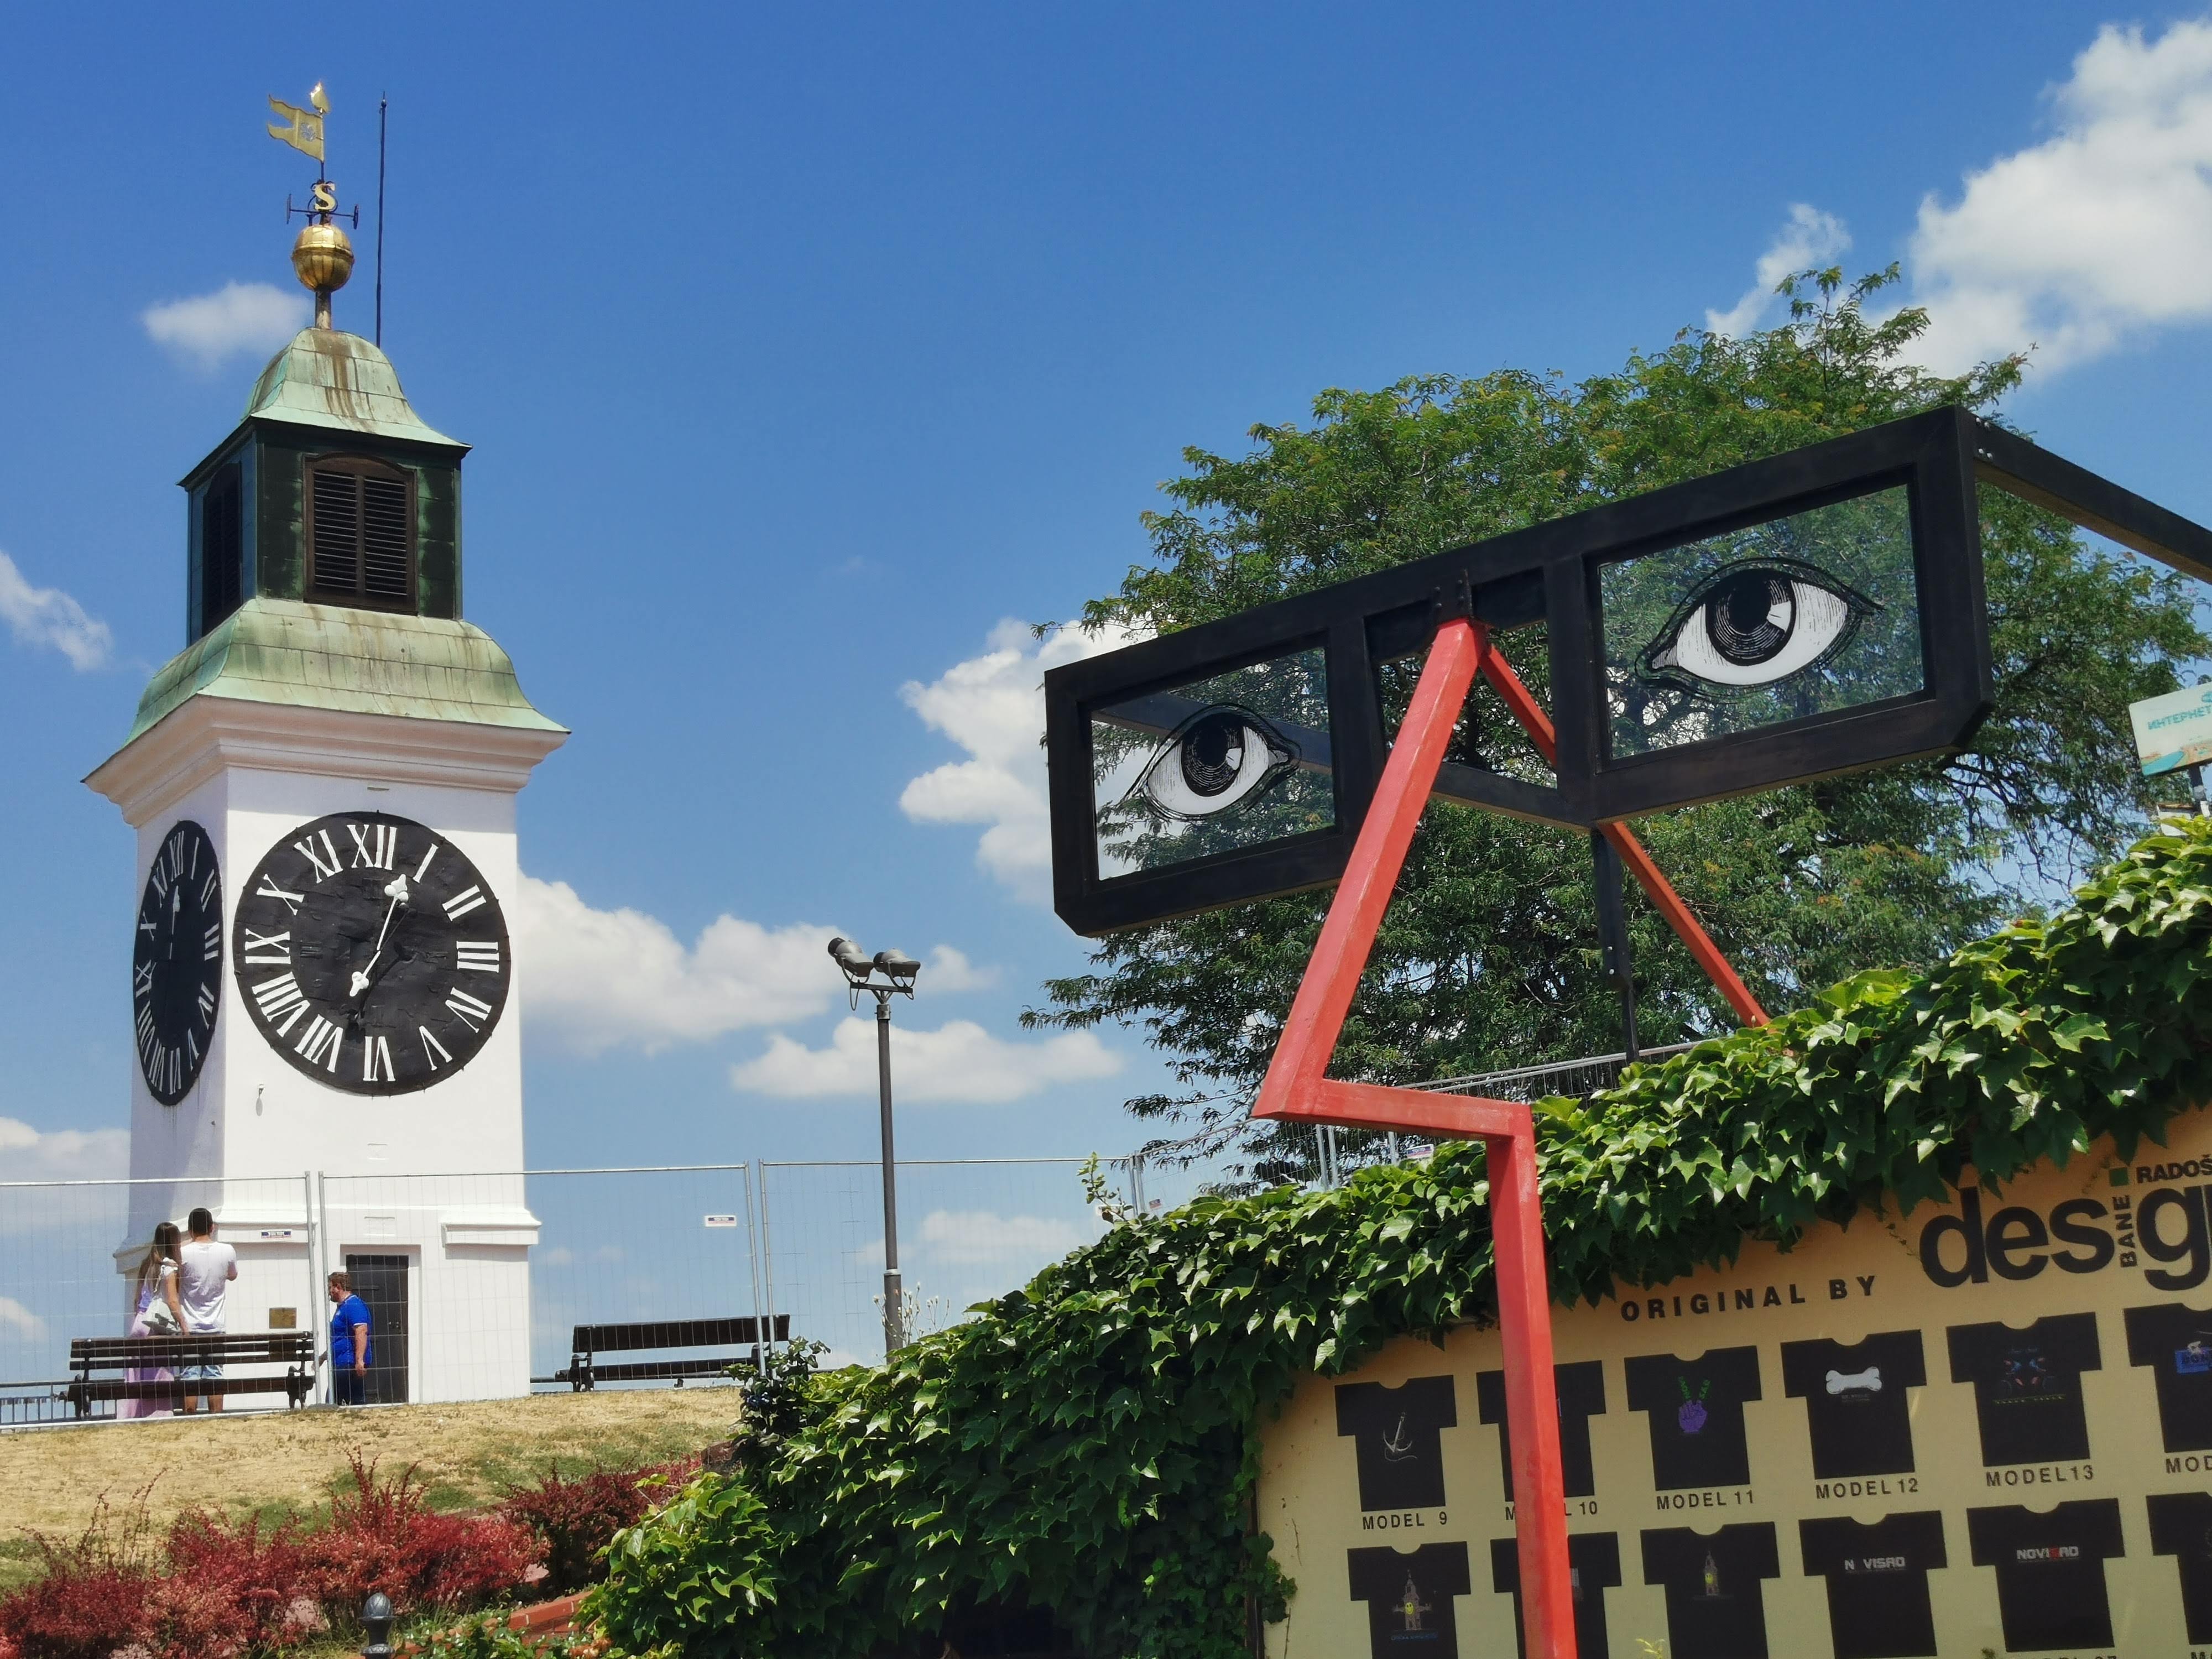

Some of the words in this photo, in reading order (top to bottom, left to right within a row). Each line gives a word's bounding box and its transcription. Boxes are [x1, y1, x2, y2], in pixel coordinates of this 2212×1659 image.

[314, 183, 336, 211] S
[294, 830, 343, 883] XI
[347, 824, 397, 870] XII
[413, 844, 438, 883] I
[257, 874, 305, 915] X
[442, 885, 486, 921] II
[245, 928, 291, 964] IX
[456, 941, 499, 973] III
[252, 972, 310, 1037] VIII
[445, 987, 492, 1032] IV
[294, 1014, 343, 1072] VII
[363, 1036, 395, 1081] VI
[419, 1026, 453, 1071] V
[2112, 1195, 2137, 1268] BANE
[1621, 1283, 1806, 1322] ORIGINAL
[1829, 1275, 1875, 1300] BY
[1815, 1480, 1891, 1499] MODEL
[1897, 1478, 1918, 1493] 12
[1986, 1467, 2067, 1486] MODEL
[2070, 1465, 2093, 1480] 13
[1579, 1501, 1598, 1515] 10
[1656, 1491, 1726, 1510] MODEL
[1735, 1490, 1754, 1505] 11
[1363, 1513, 1425, 1530] MODEL
[1439, 1511, 1447, 1525] 9
